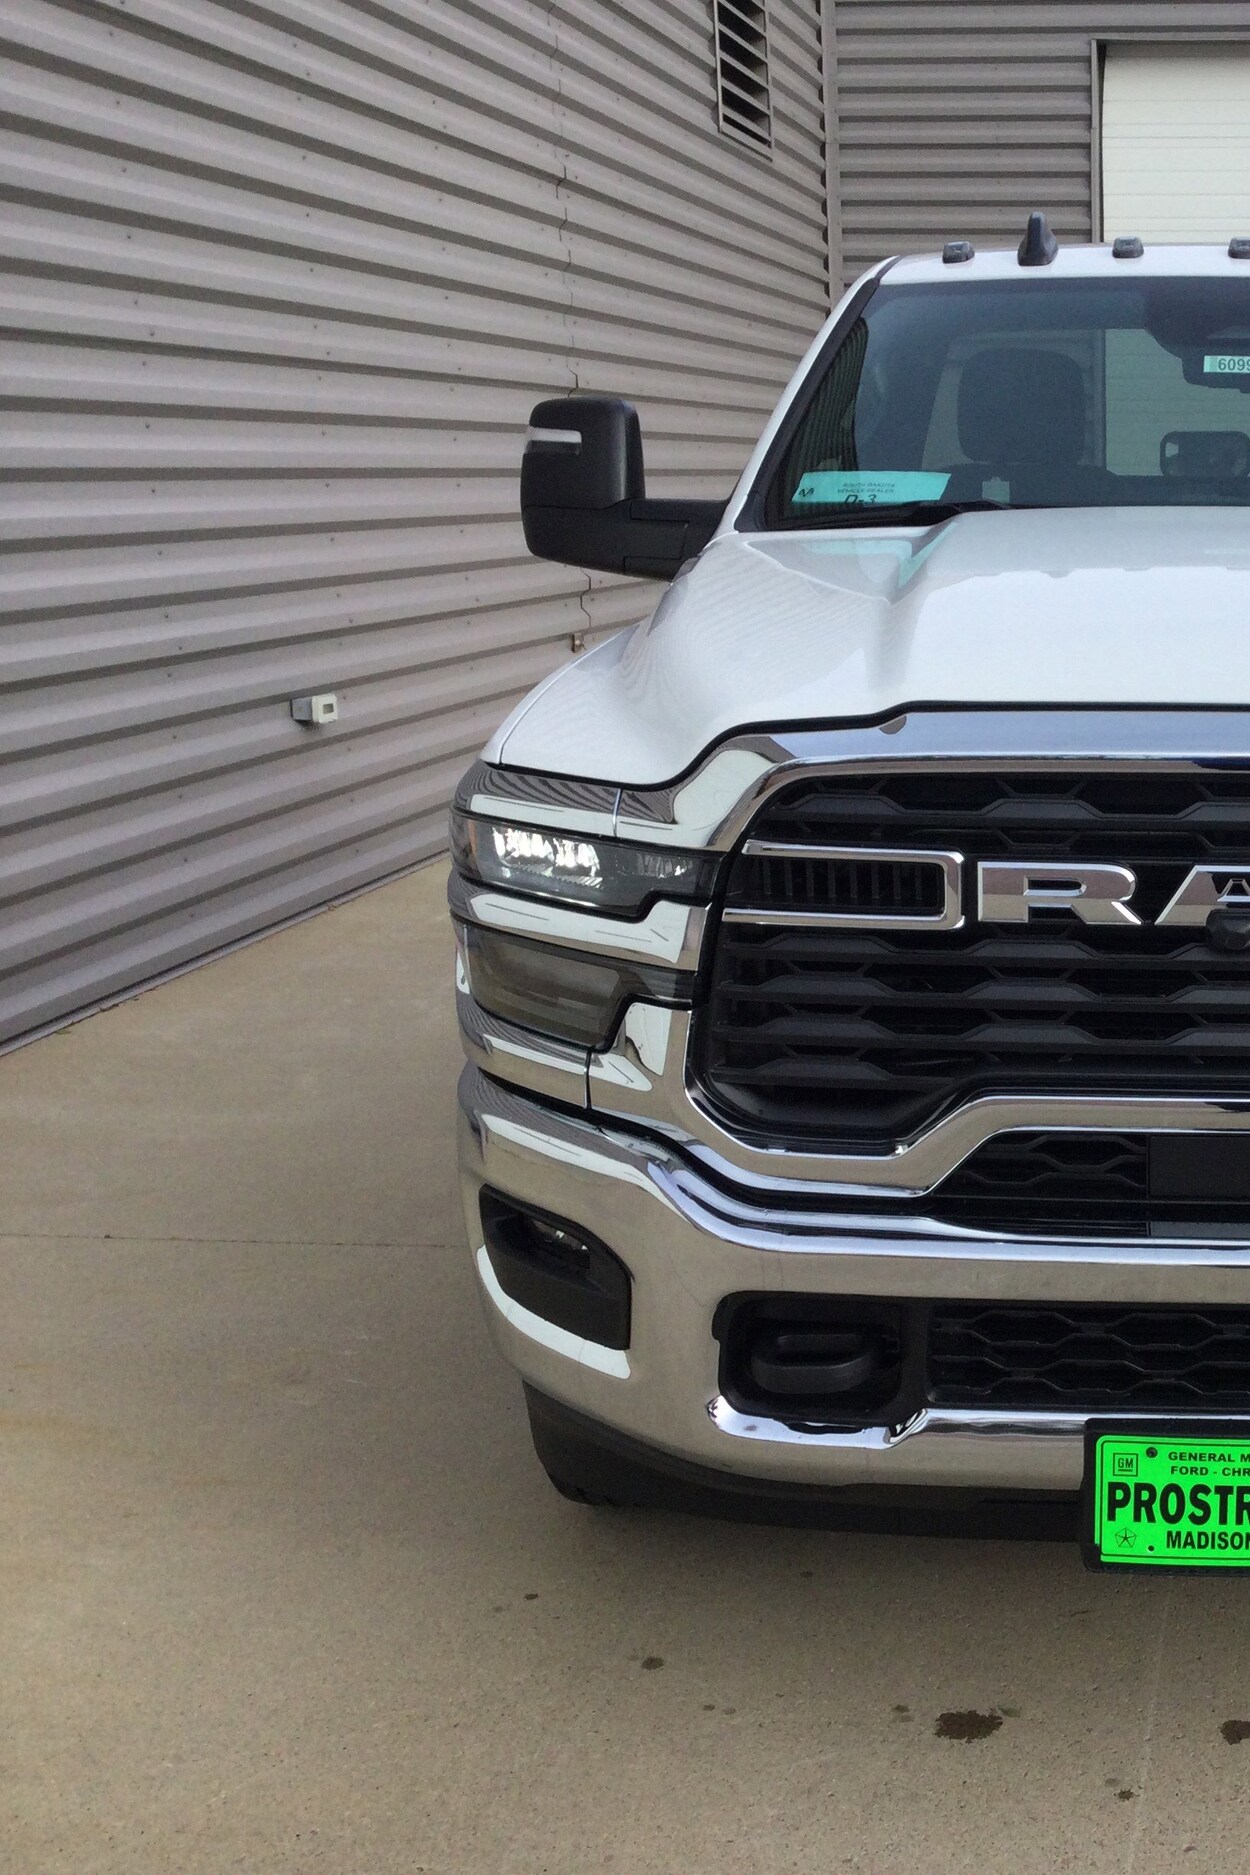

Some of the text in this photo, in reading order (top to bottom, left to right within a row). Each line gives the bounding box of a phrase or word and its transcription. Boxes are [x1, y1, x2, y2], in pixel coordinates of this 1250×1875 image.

[1117, 1457, 1134, 1469] GM
[1168, 1451, 1236, 1463] GENERAL
[1170, 1466, 1209, 1476] FORD
